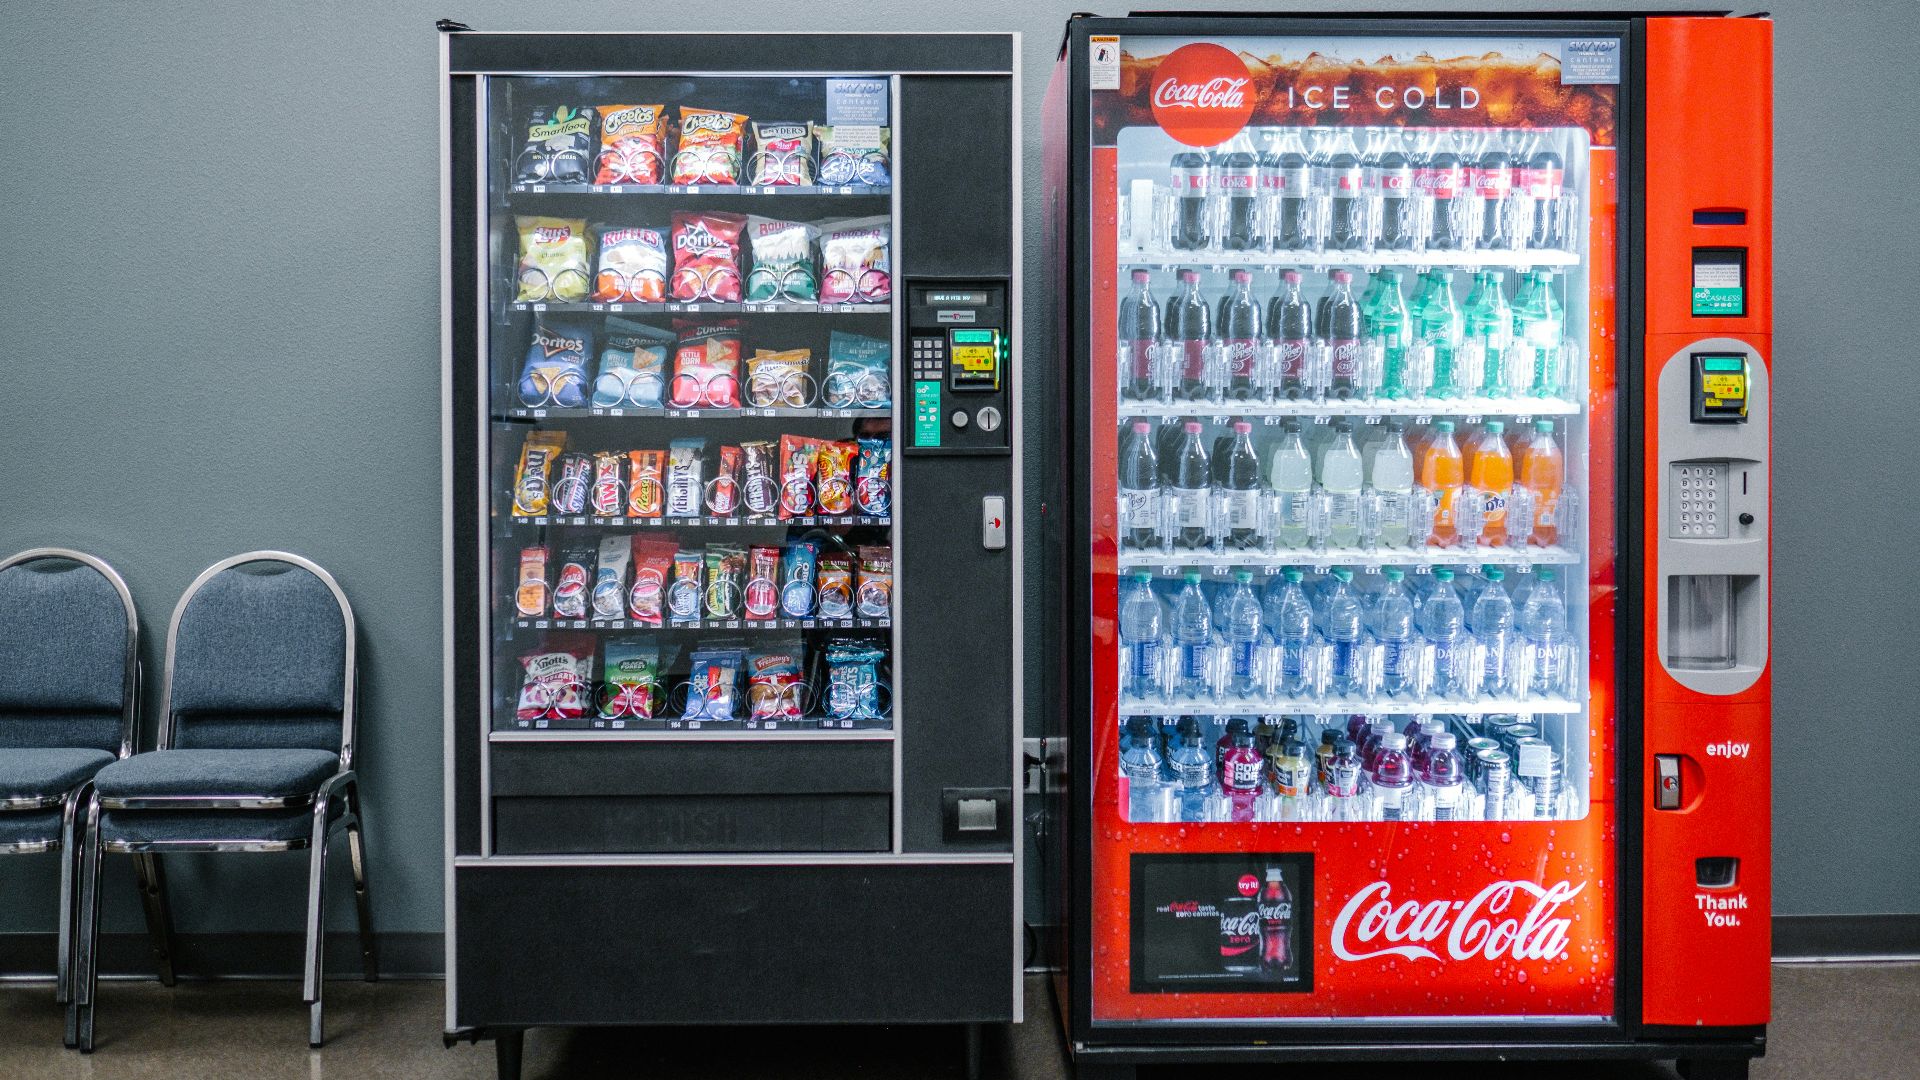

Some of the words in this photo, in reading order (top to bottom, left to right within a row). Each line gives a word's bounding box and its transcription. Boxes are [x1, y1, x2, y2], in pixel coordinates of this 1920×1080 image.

[1154, 77, 1250, 109] Coca-Cola
[1288, 86, 1350, 110] ICE
[1375, 86, 1480, 110] COLD
[532, 121, 587, 139] Smartfood
[605, 108, 655, 134] Cheetos
[683, 114, 734, 136] Cheetos
[1221, 176, 1248, 188] Coke
[603, 228, 659, 247] RUFFLES
[531, 332, 584, 351] Doritos
[1423, 329, 1449, 341] Sprite
[567, 460, 592, 514] SNICERS
[599, 464, 619, 512] TWIX
[535, 655, 569, 670] Knott's
[1706, 740, 1750, 758] enjoy
[1238, 882, 1250, 890] try
[1156, 905, 1170, 913] real
[1694, 894, 1748, 910] Thank
[1175, 910, 1192, 918] zero
[1330, 880, 1587, 961] Coca-Cola
[1704, 911, 1741, 927] You.
[1229, 934, 1251, 944] zero
